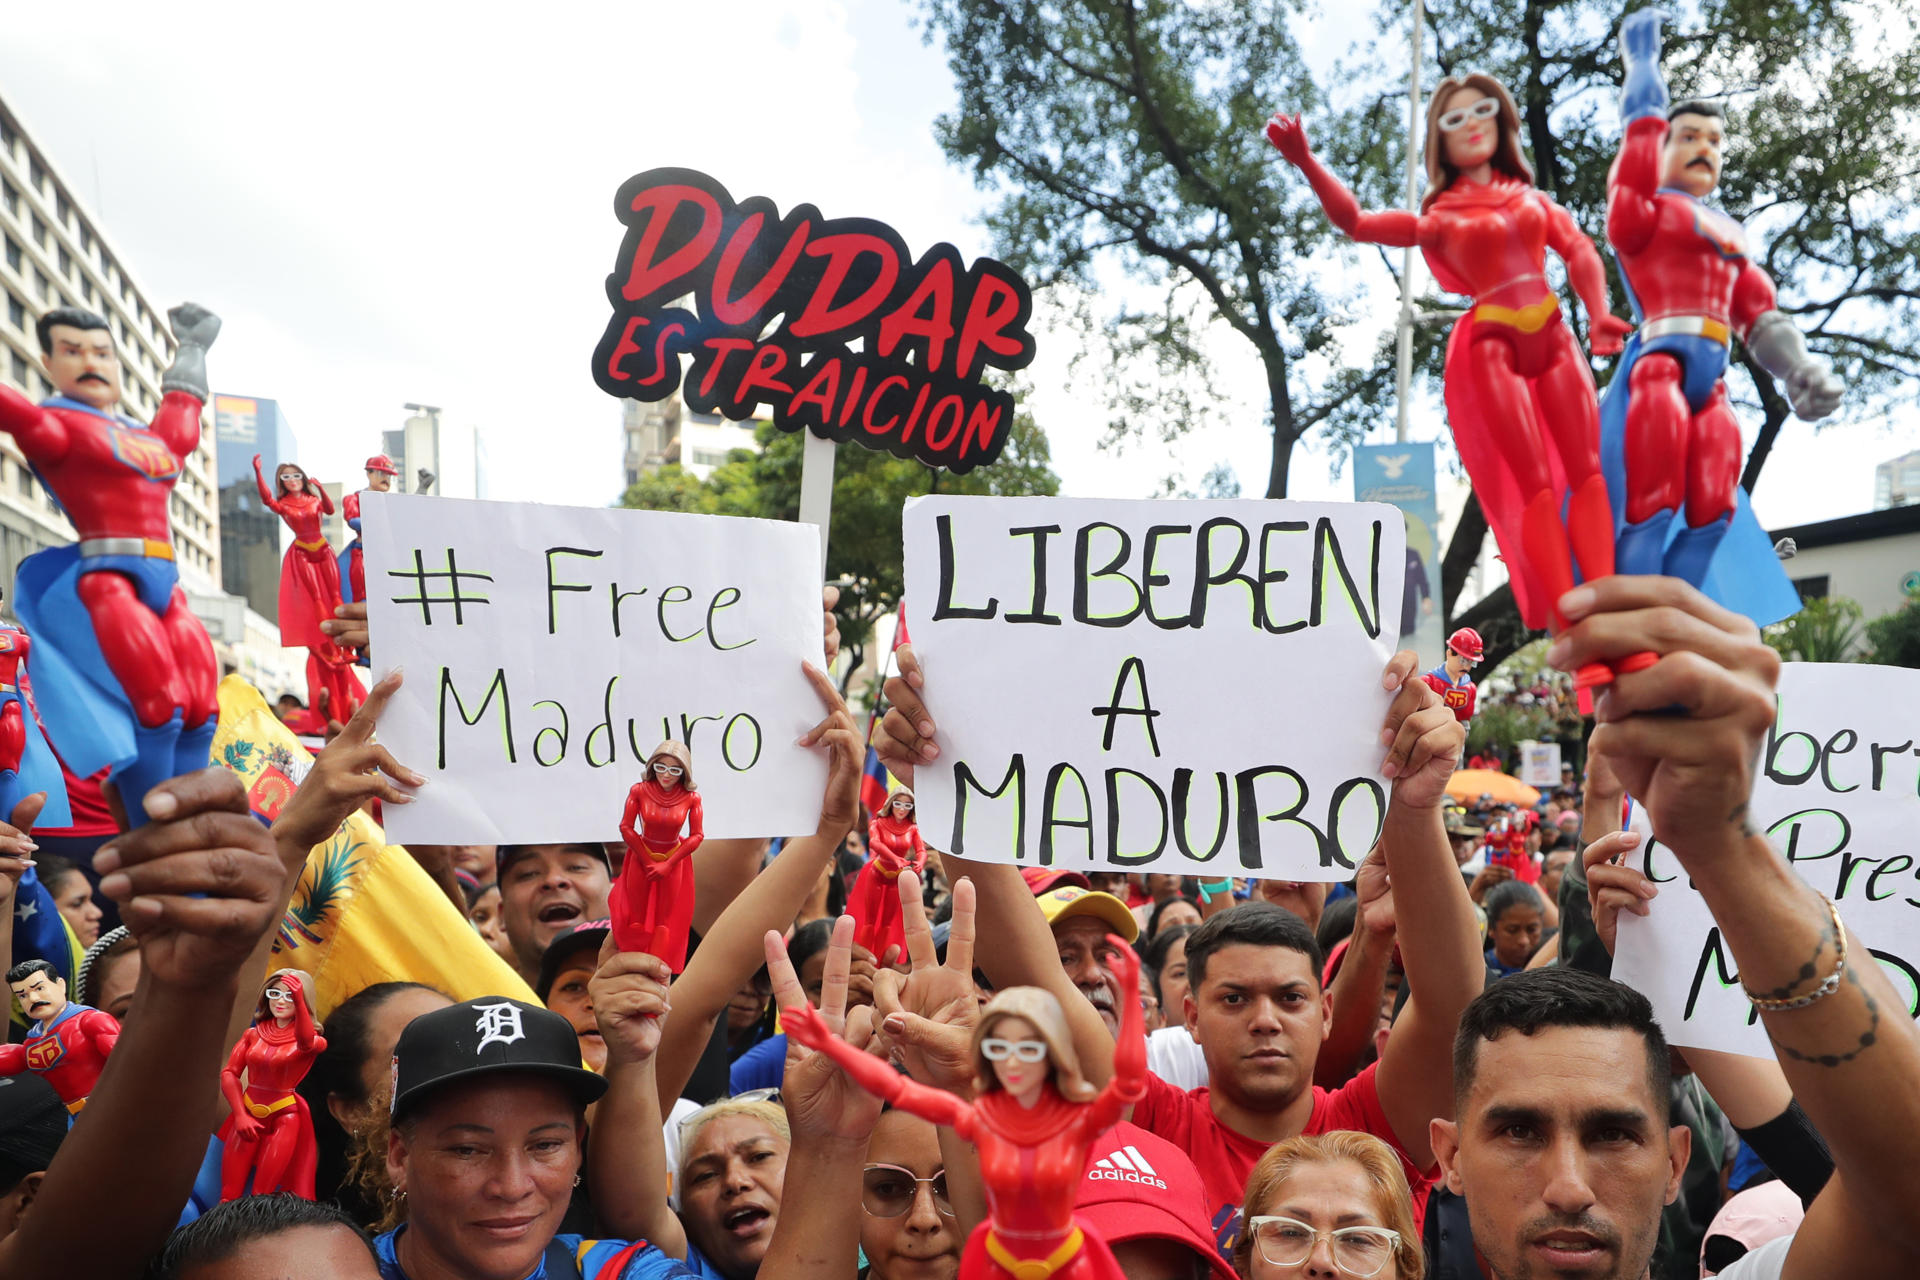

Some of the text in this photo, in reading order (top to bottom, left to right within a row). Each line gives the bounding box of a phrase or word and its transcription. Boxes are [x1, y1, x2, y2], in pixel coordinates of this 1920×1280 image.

[622, 184, 1024, 379] DUDAR
[608, 316, 1001, 460] ES TRAICION
[545, 547, 757, 651] Free
[932, 514, 1382, 639] LIBEREN
[438, 665, 762, 773] Maduro
[1092, 655, 1161, 757] A
[951, 753, 1386, 870] MADURO
[1088, 1167, 1168, 1190] adidas
